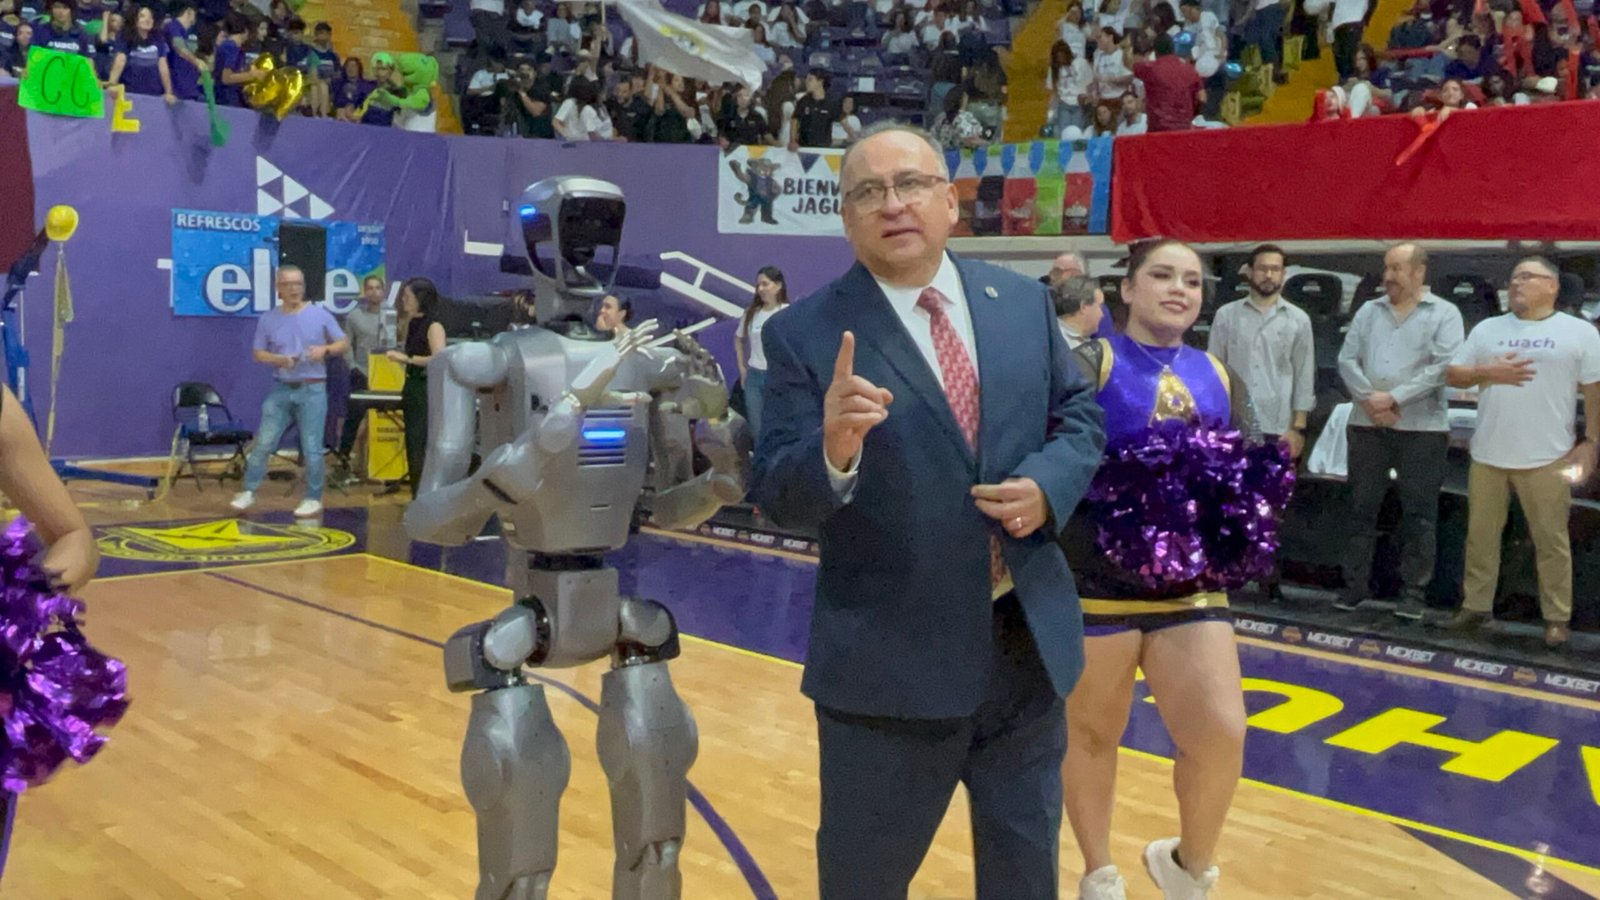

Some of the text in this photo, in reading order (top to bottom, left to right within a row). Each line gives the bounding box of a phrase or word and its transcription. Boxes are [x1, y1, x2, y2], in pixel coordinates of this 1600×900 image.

[176, 212, 262, 232] REFRESCOS
[1234, 618, 1279, 635] MEXBET
[1306, 631, 1354, 648] MEXBET
[1385, 645, 1437, 663] MEXBET
[1453, 657, 1509, 676] MEXBET
[1543, 673, 1600, 693] MEXBET
